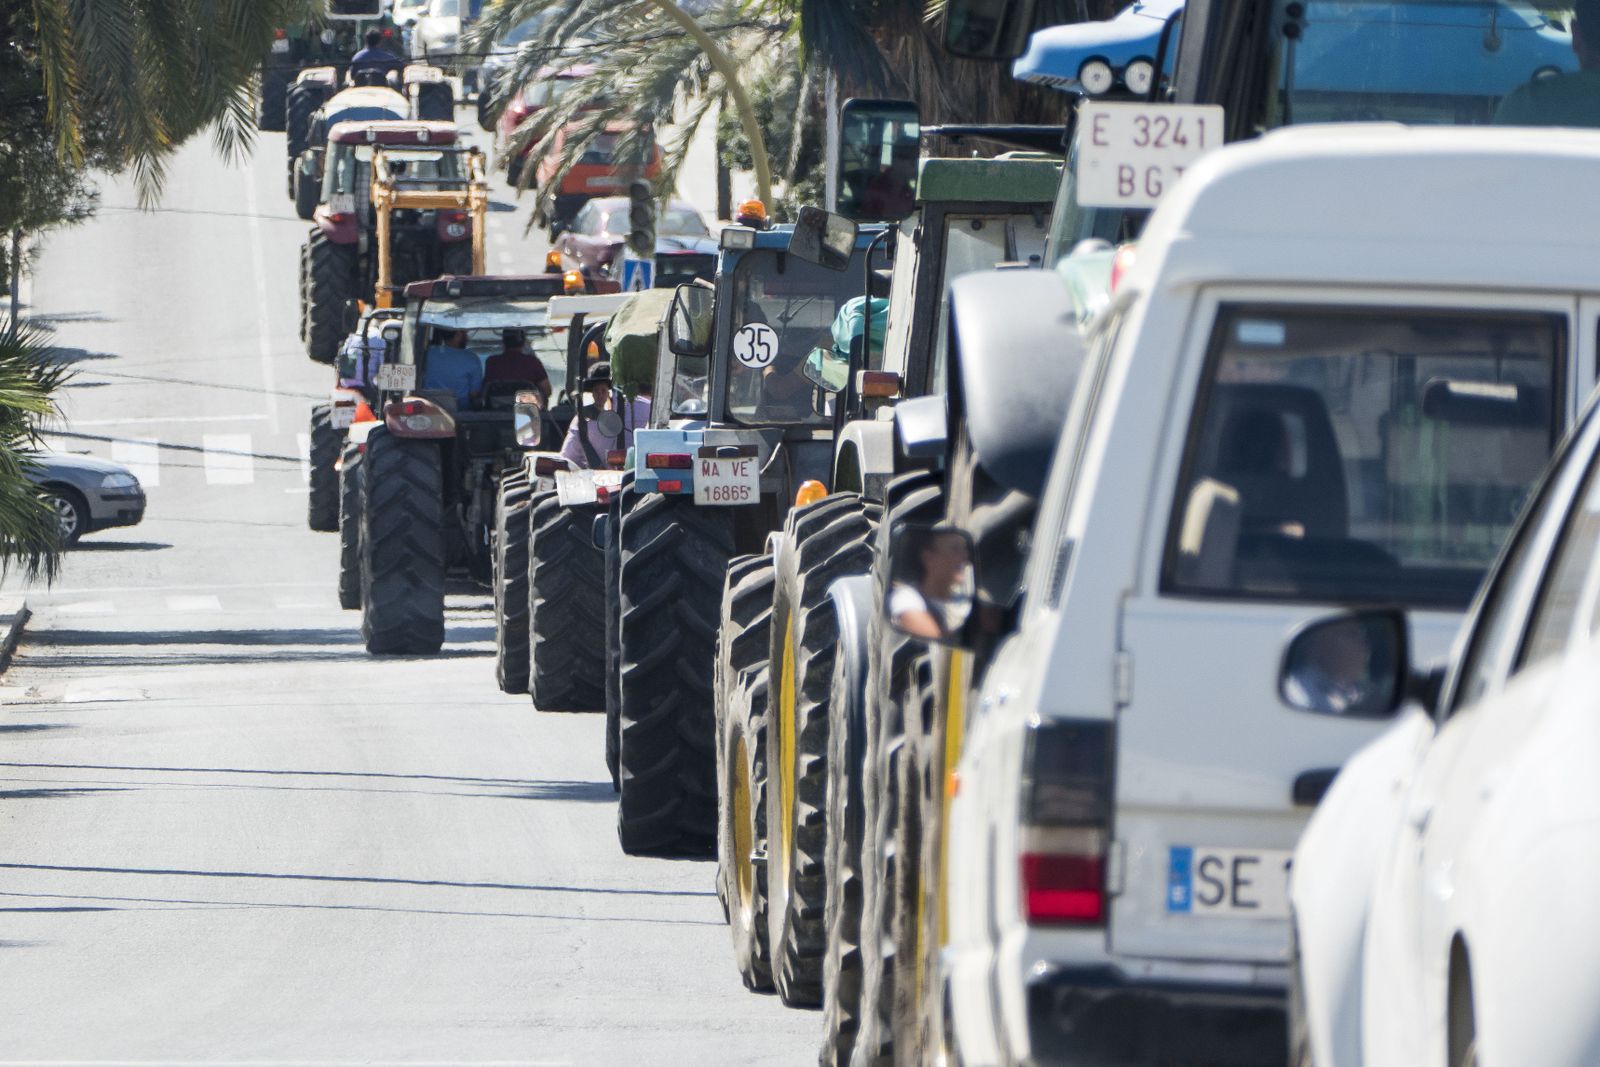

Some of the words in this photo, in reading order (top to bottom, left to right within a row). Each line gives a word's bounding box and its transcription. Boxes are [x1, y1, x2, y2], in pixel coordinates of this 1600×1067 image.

[1092, 112, 1111, 147] E
[1133, 114, 1205, 149] 3241
[740, 326, 771, 364] 35
[702, 460, 720, 478] MA
[731, 460, 749, 478] VE
[705, 484, 750, 502] 16865
[1197, 854, 1261, 909] SE
